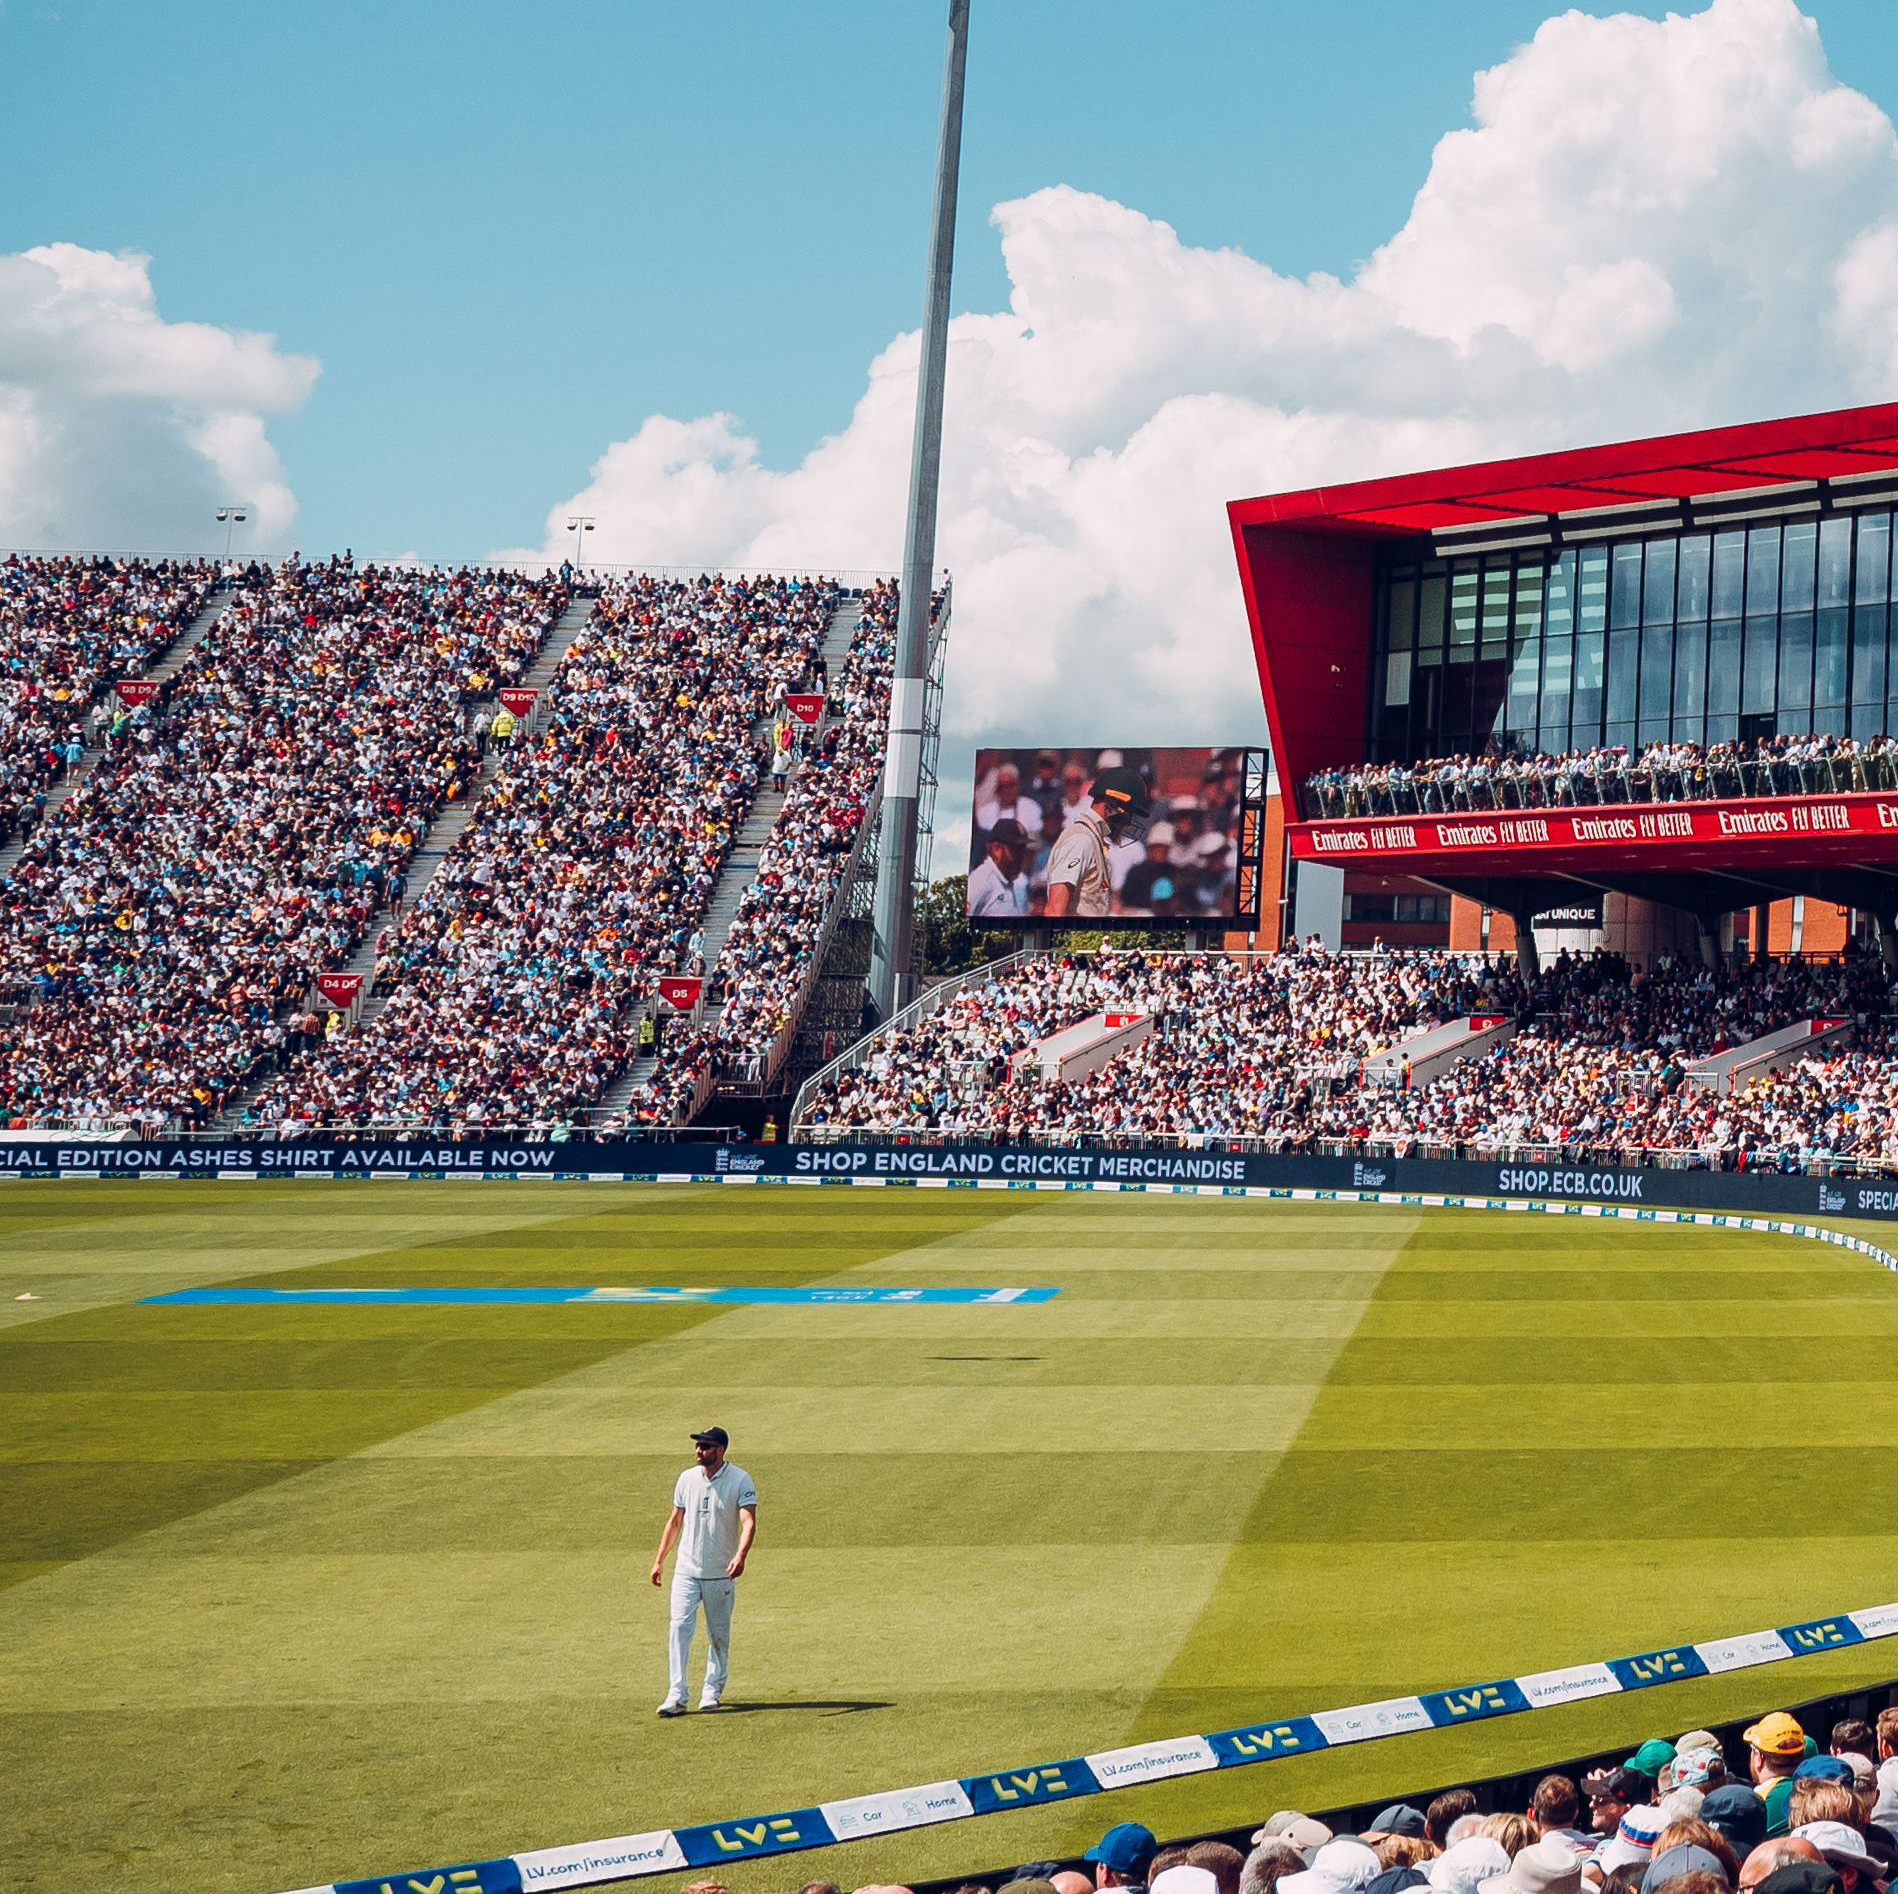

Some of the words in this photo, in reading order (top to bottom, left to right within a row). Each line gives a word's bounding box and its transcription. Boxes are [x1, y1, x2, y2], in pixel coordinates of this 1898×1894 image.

[797, 704, 814, 712] D10
[1436, 821, 1497, 846] Emirates
[1500, 822, 1517, 844] FLY
[1518, 820, 1549, 842] BETTER
[1571, 816, 1636, 841] Emirates
[1639, 816, 1656, 838] FLY
[1657, 813, 1694, 837] BETTER
[1717, 809, 1788, 835] Emirates
[1792, 808, 1809, 831] FLY
[1810, 805, 1850, 830] BETTER
[1311, 827, 1368, 851] Emirates
[1371, 828, 1386, 849] FLY
[1386, 826, 1417, 848] BETTER
[1552, 909, 1595, 919] UNIQUE
[324, 980, 339, 988] D4
[672, 989, 688, 998] D5
[57, 1150, 161, 1166] EDITION
[169, 1150, 252, 1166] ASHES
[260, 1150, 334, 1166] SHIRT
[341, 1150, 483, 1166] AVAILABLE
[491, 1150, 555, 1166] NOW
[795, 1152, 867, 1171] SHOP
[875, 1152, 993, 1173] ENGLAND
[1001, 1155, 1093, 1175] CRICKET
[1099, 1158, 1245, 1180] MERCHANDISE
[1499, 1169, 1643, 1198] SHOP.ECB.CO.UK
[1394, 1709, 1420, 1722] Home
[1103, 1750, 1202, 1778] LV.com/insurance
[862, 1809, 884, 1822] Car
[926, 1795, 958, 1810] Home
[526, 1847, 665, 1880] LV.com/insurance
